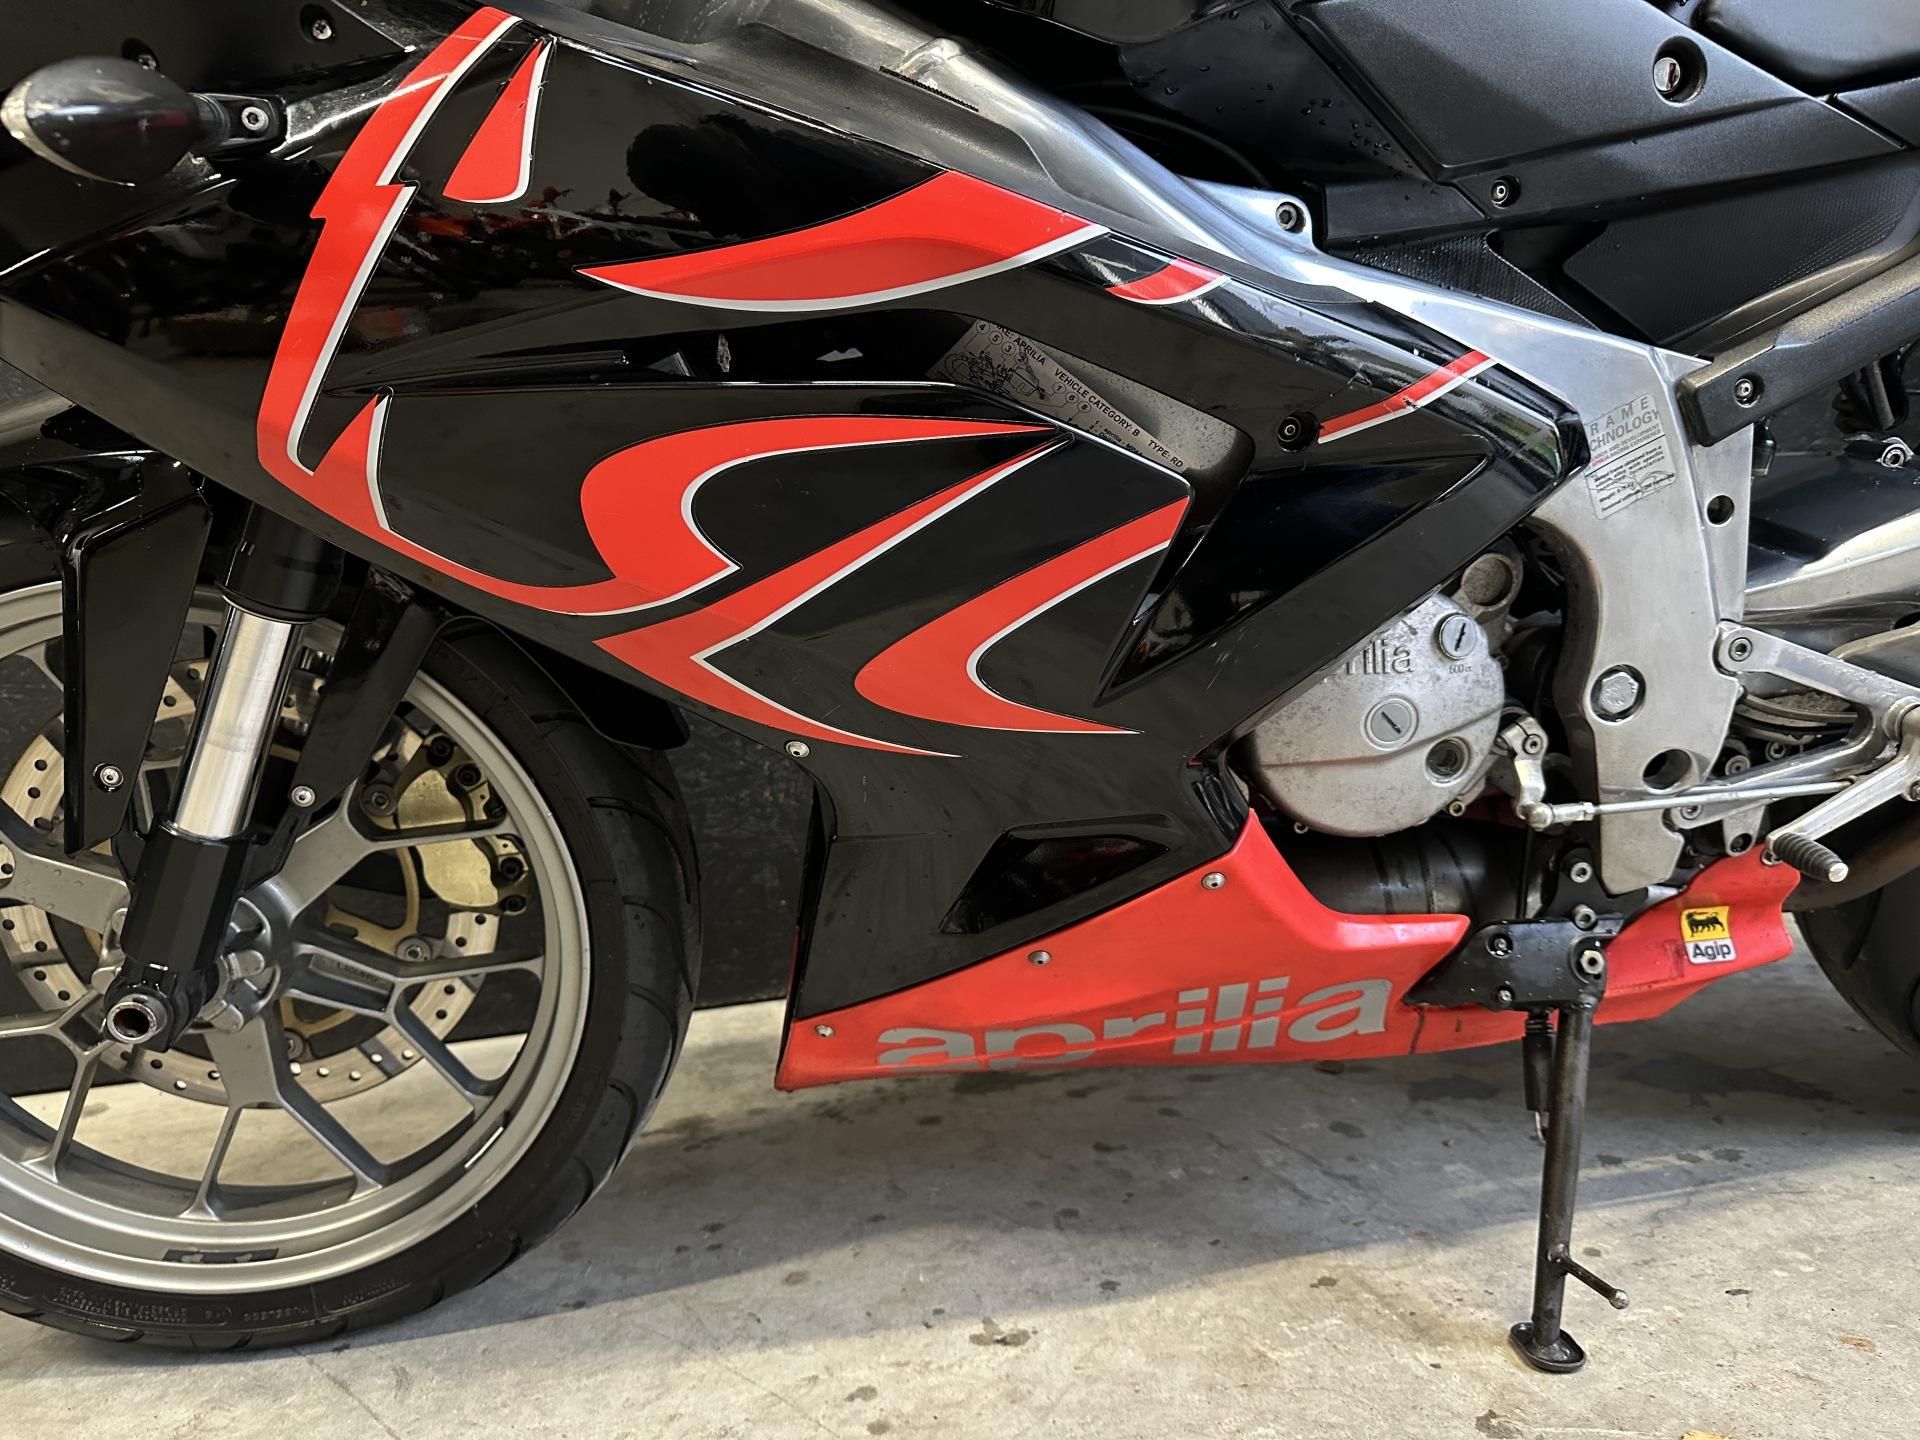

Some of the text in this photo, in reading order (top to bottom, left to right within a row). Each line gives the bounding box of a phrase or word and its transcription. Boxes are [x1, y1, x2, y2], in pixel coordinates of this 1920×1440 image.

[1014, 336, 1046, 366] APRILIA
[1054, 368, 1090, 400] VEHICLE
[1088, 395, 1133, 432] CATEGORY:
[1132, 428, 1141, 438] B
[1147, 439, 1170, 460] TYPE:
[1169, 455, 1184, 469] RD
[1589, 396, 1649, 437] RAME
[1588, 408, 1660, 452] CHNOLOGY
[1692, 941, 1731, 960] Agip
[876, 976, 1393, 1069] aprilia
